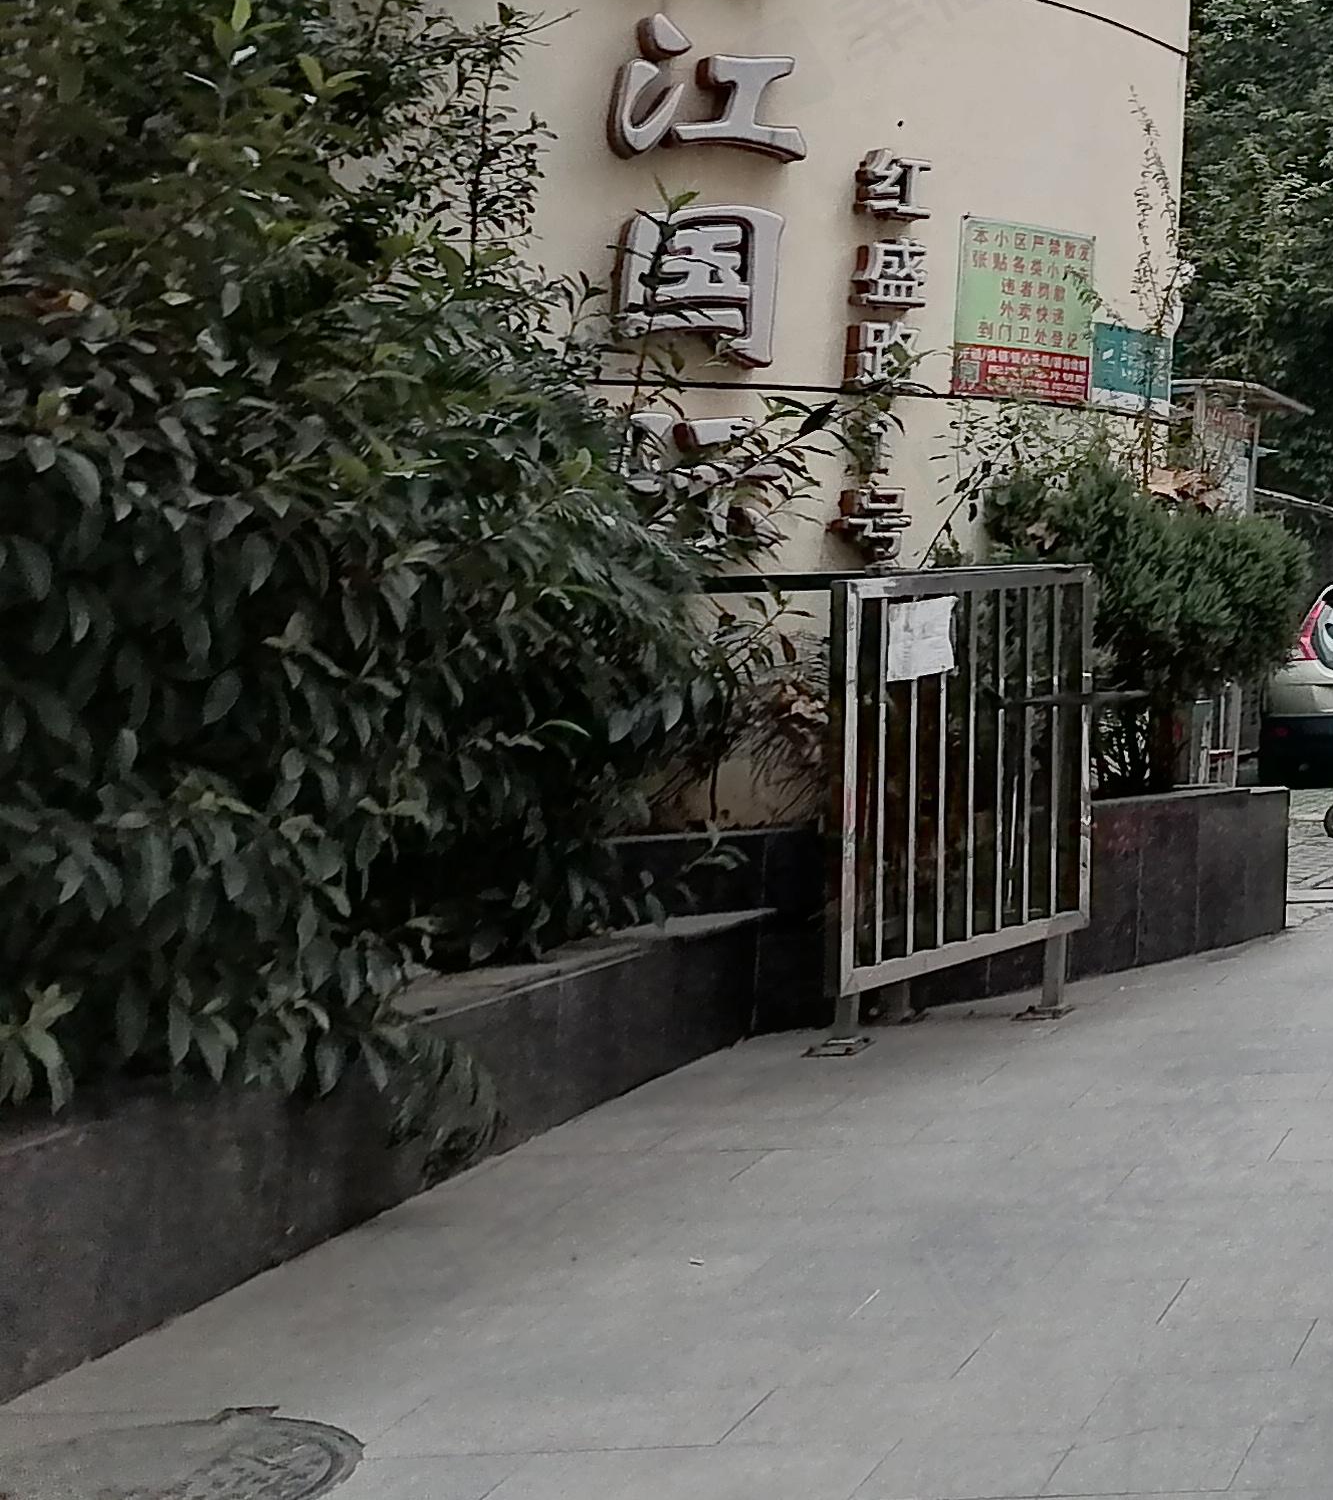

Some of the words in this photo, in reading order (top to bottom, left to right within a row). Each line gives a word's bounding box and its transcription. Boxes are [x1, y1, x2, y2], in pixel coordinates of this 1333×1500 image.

[838, 148, 932, 575] 红盛路号
[977, 320, 1080, 350] 到门卫处登记
